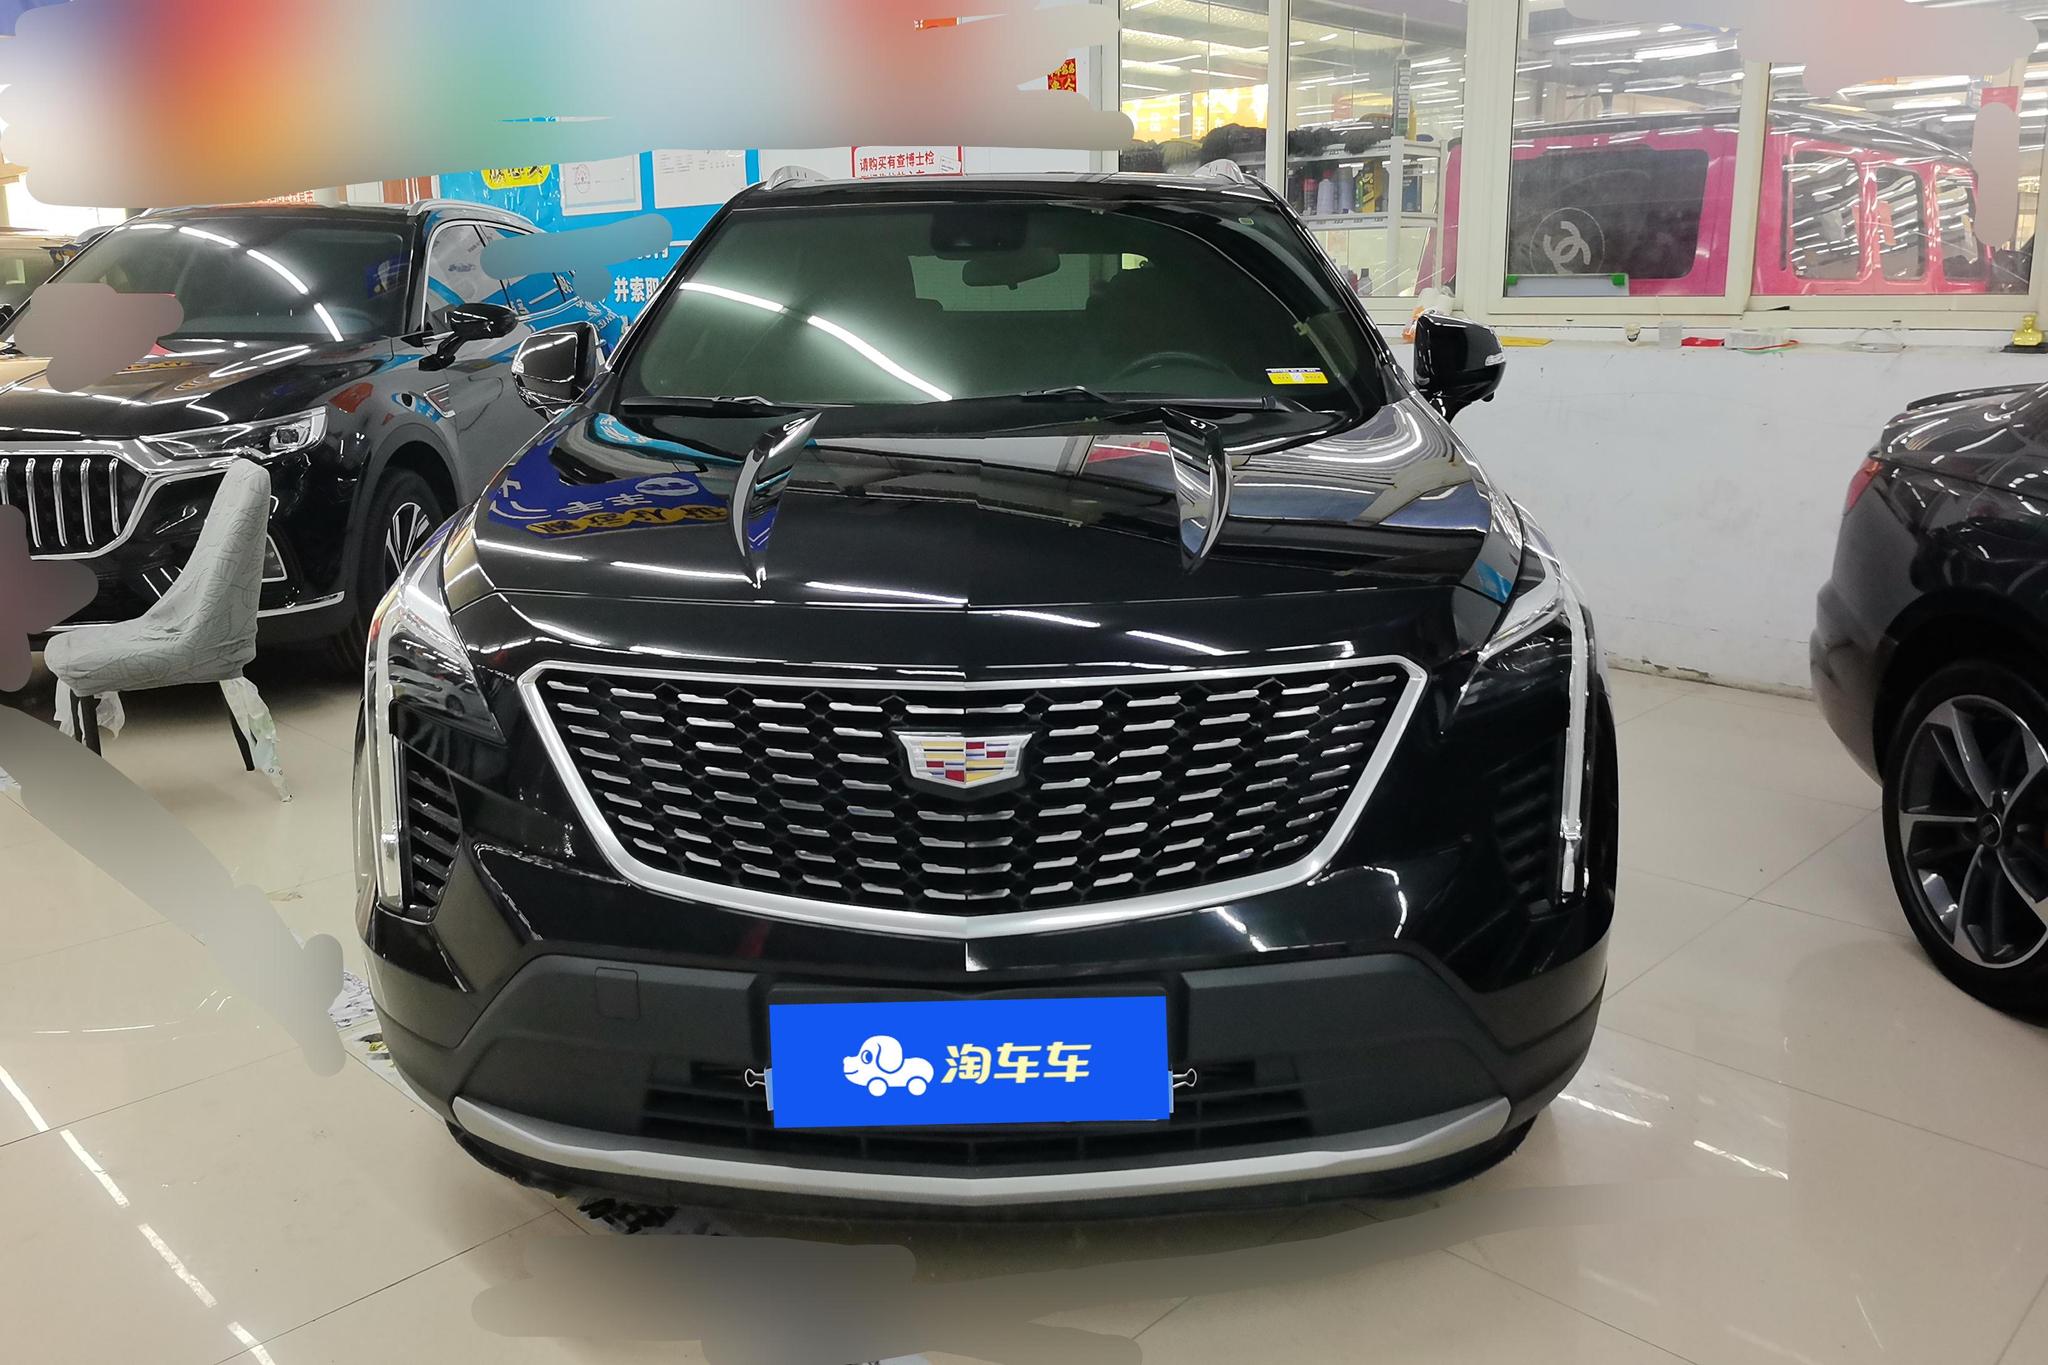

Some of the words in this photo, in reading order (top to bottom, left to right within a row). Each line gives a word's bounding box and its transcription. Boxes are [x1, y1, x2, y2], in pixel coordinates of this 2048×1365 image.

[859, 150, 935, 172] 请购买有查博士检
[614, 275, 665, 303] 并索取
